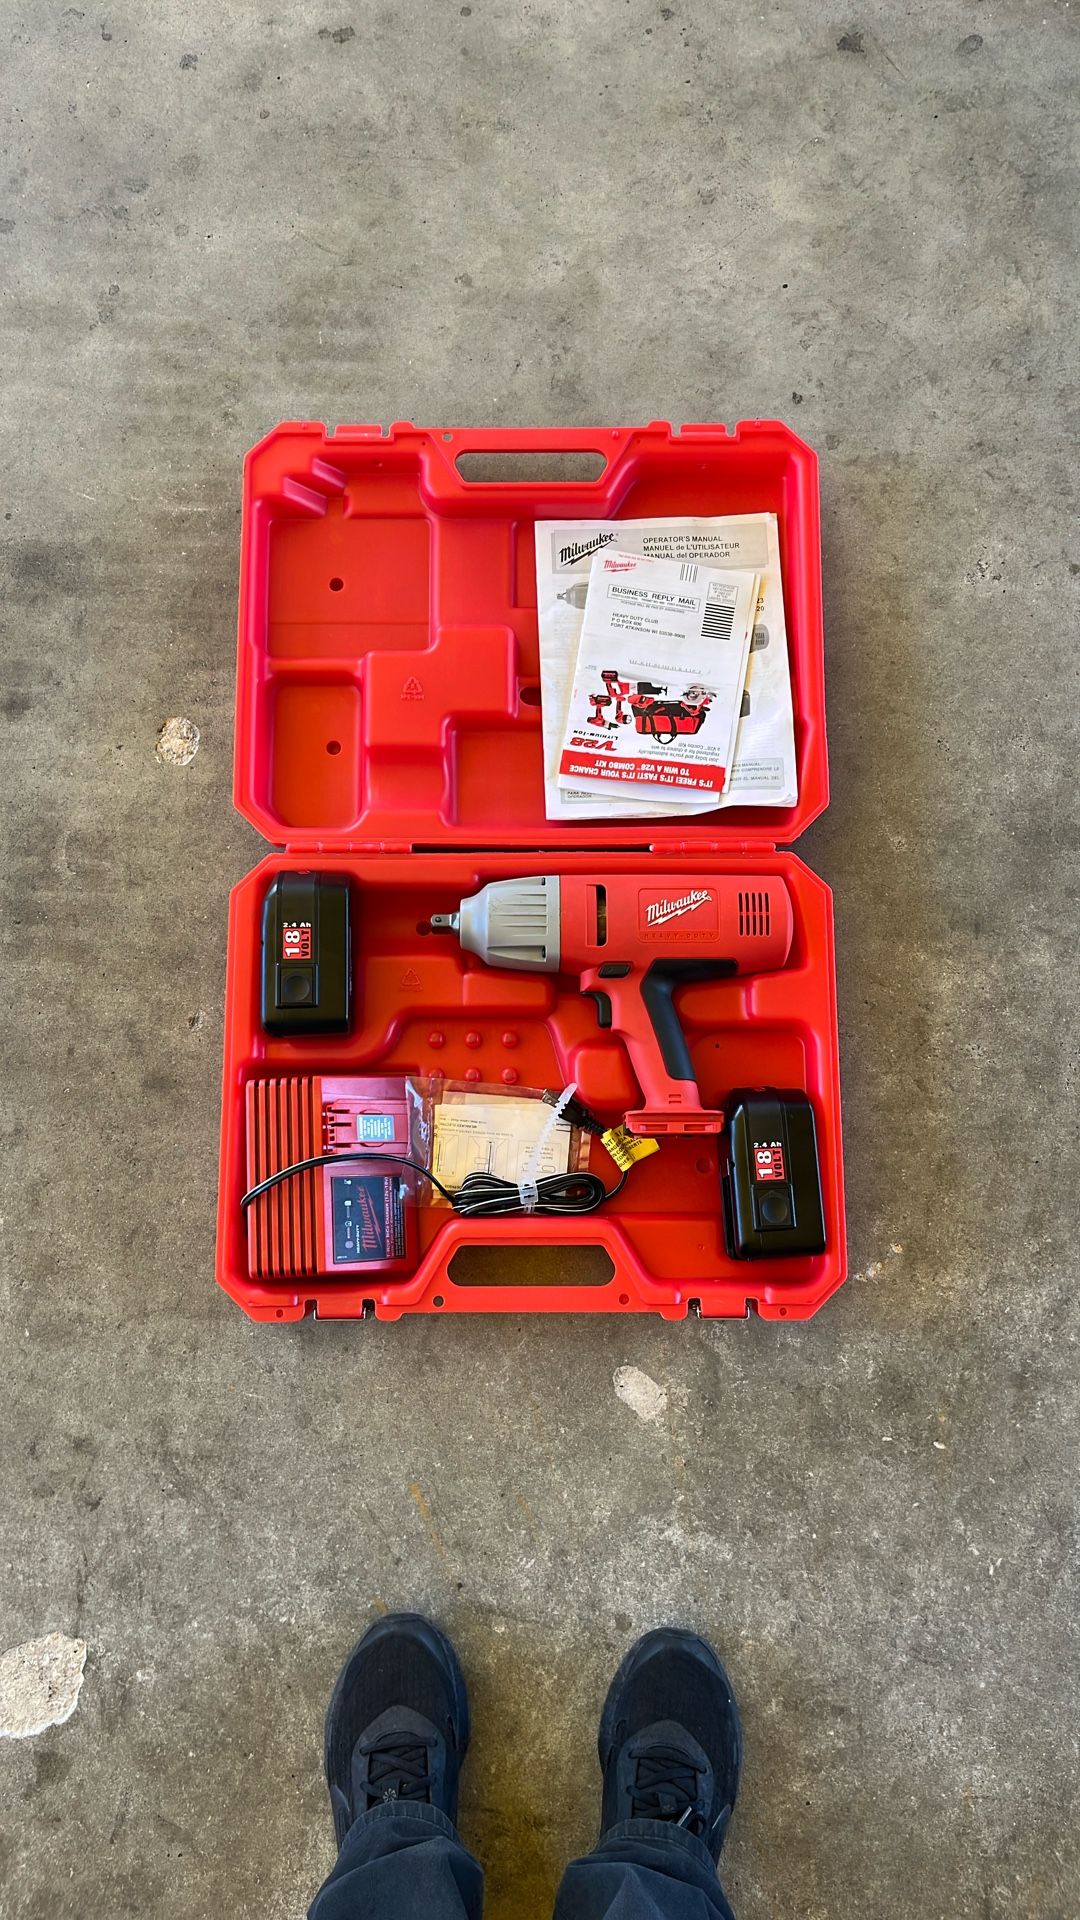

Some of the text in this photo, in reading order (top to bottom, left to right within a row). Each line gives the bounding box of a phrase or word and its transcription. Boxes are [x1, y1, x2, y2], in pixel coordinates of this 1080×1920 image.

[559, 533, 615, 564] Milwaukee
[603, 560, 637, 570] Milwaukee
[612, 587, 648, 598] BUSINESS
[652, 593, 675, 602] REPLY
[678, 598, 696, 606] MAIL
[625, 625, 651, 633] ATKINSON
[570, 737, 617, 751] V28
[573, 729, 619, 740] LITHIUM-ION
[595, 759, 607, 768] KIT
[608, 761, 635, 770] COMBO
[664, 765, 679, 775] WIN
[680, 768, 689, 776] TO
[569, 764, 713, 788] IT'S FREE! IT'S FAST! IT'S YOUR CHANCE
[645, 890, 709, 923] Milwaukee
[285, 930, 300, 957] 18
[301, 929, 310, 957] VOLT
[757, 1150, 773, 1178] 18
[773, 1149, 783, 1178] VOLT
[357, 1185, 379, 1252] Milwaukee
